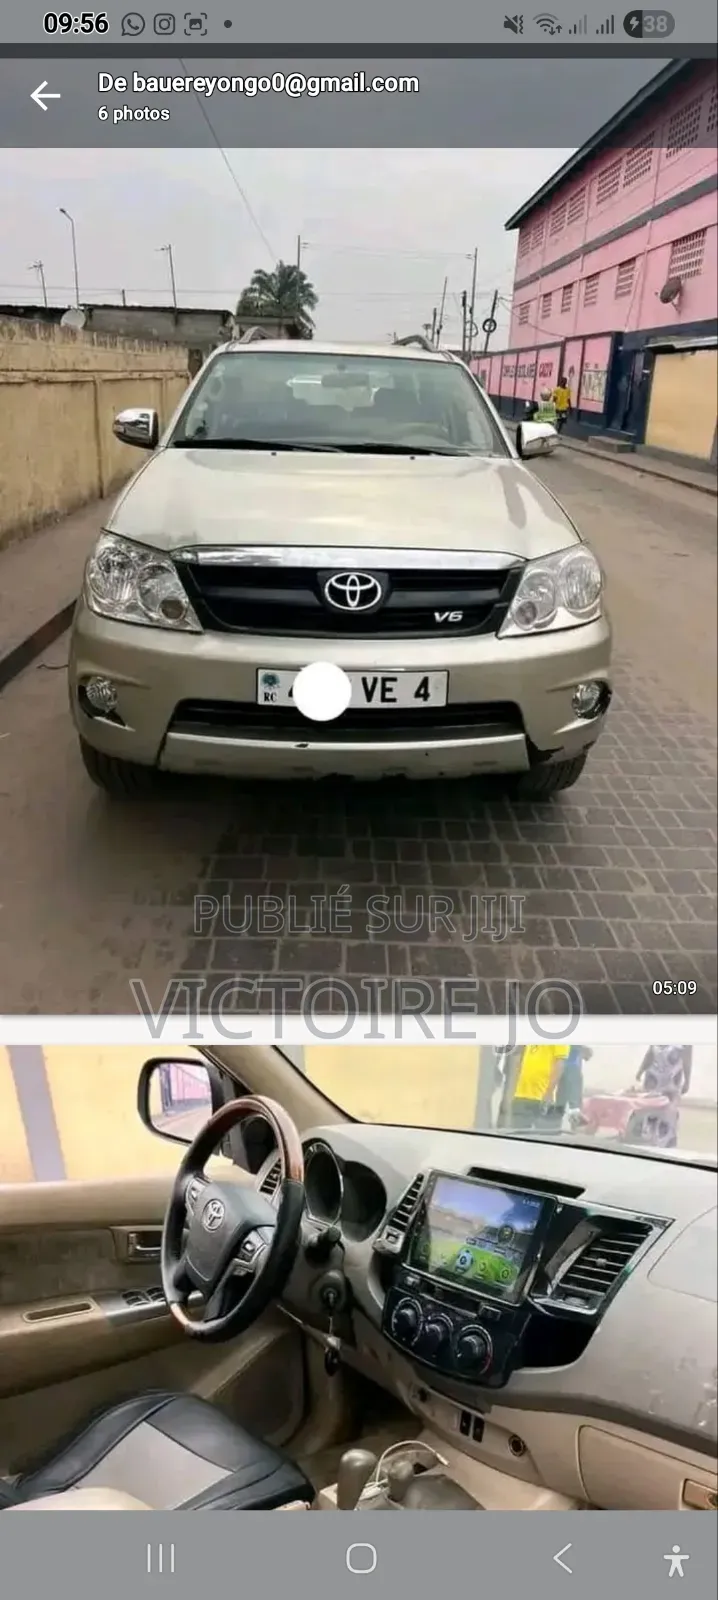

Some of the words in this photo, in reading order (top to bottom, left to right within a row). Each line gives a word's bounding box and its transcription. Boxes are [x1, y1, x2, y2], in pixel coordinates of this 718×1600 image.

[434, 610, 463, 623] V6
[361, 676, 398, 703] VE
[414, 676, 431, 702] 4
[263, 692, 277, 703] RC
